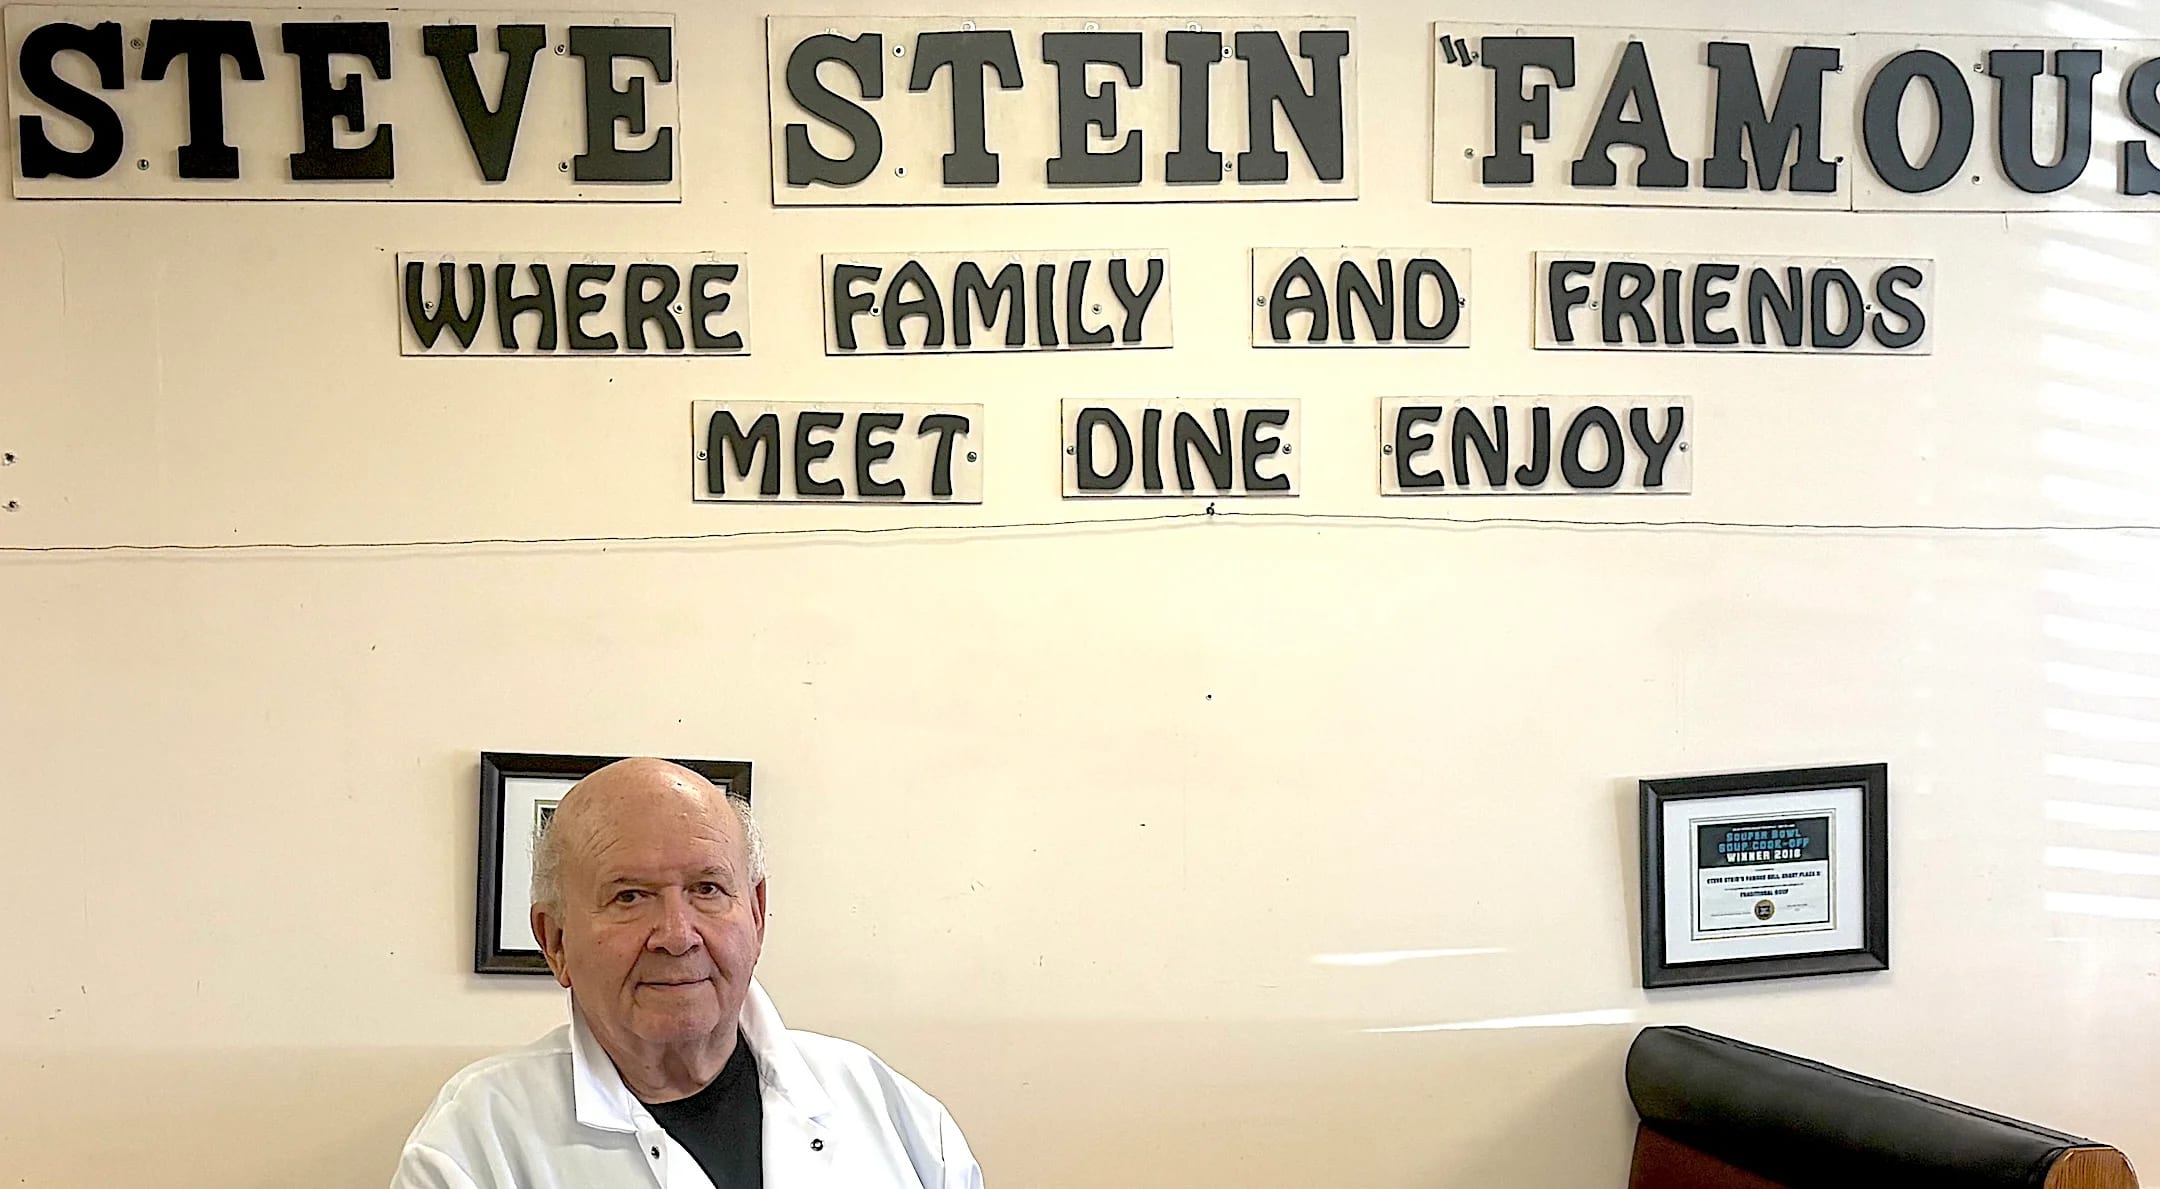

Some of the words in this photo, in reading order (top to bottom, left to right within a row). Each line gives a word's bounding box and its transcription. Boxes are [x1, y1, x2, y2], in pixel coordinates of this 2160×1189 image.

[19, 19, 673, 182] STEVE
[786, 30, 1350, 186] STEIN
[405, 261, 743, 350] WHERE
[833, 259, 1163, 349] FAMILY
[1269, 257, 1460, 342] AND
[1549, 260, 1926, 349] FRIENDS
[708, 410, 969, 496] MEET
[1076, 408, 1291, 491] DINE
[1396, 405, 1684, 489] ENJOY
[1719, 842, 1749, 853] SOUP
[1752, 837, 1809, 850] COOK-OFF
[1726, 831, 1768, 841] SOUPER
[1771, 829, 1801, 839] BOWL
[1726, 851, 1770, 863] WINNER
